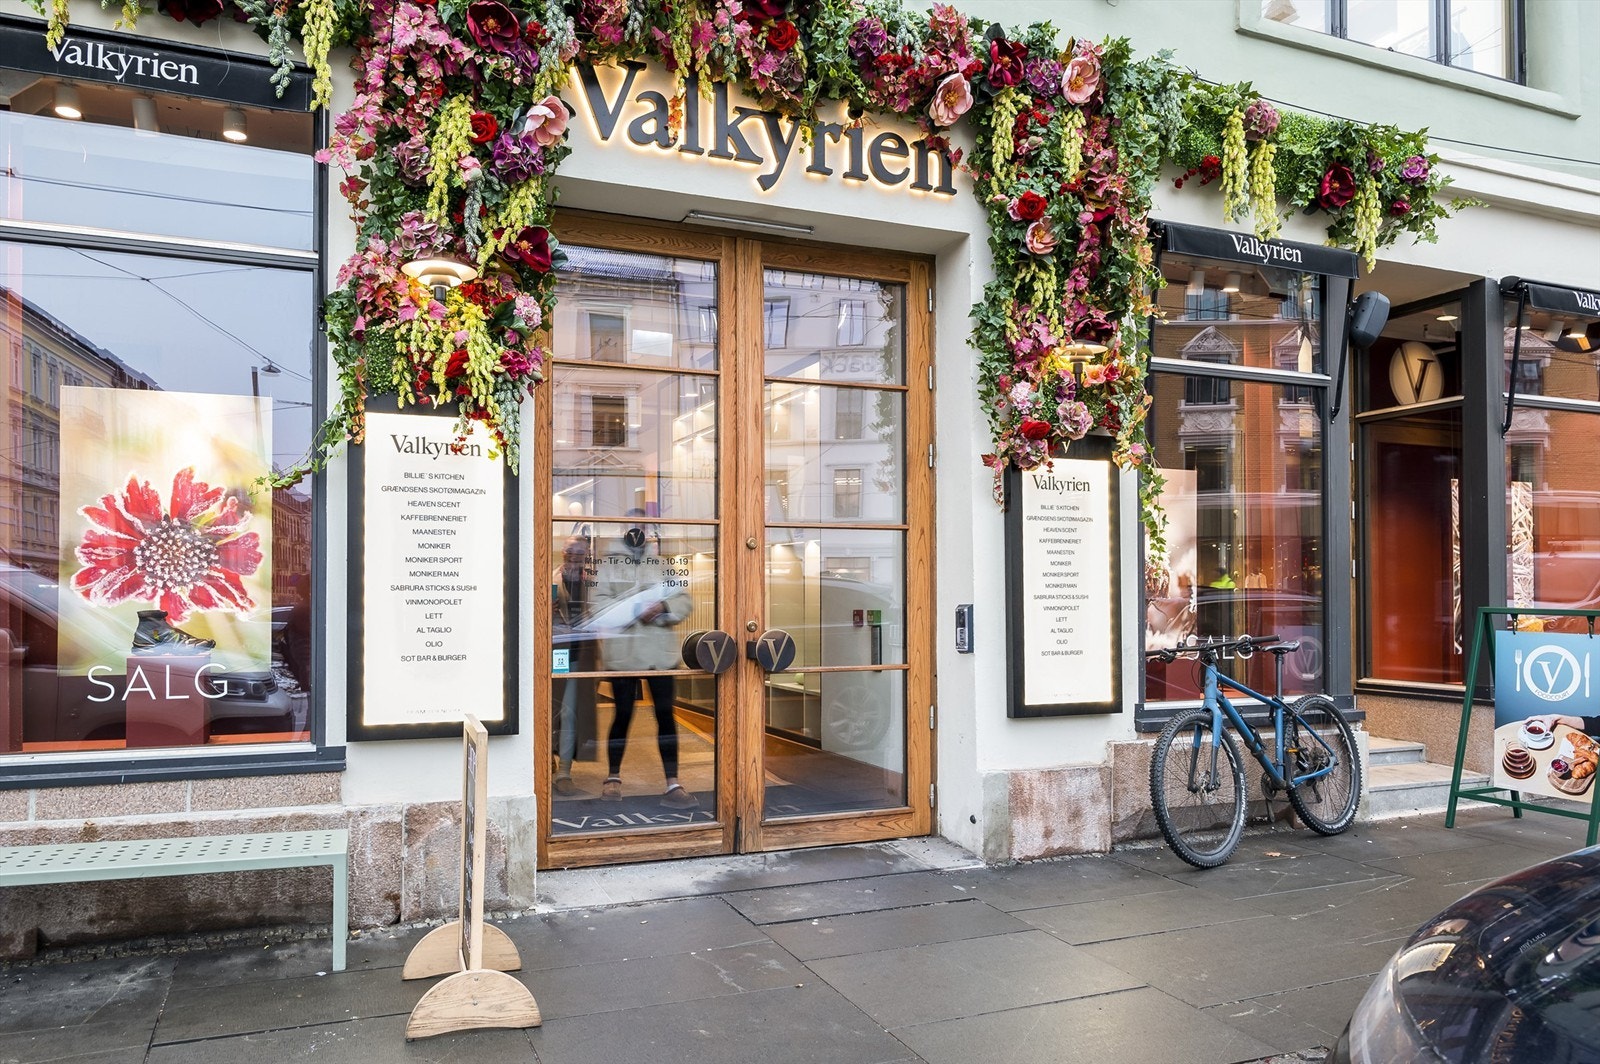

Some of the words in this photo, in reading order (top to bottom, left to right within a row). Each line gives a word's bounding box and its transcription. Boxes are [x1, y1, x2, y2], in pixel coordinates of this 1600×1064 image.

[50, 38, 199, 85] Valkyrien
[575, 58, 957, 196] Valkyrien
[1229, 234, 1303, 264] Valkyrien
[434, 472, 465, 480] KITCHEN
[1032, 474, 1091, 495] Valkyrien
[381, 486, 428, 495] GRÆNDSENS
[428, 486, 487, 495] SKOTØIMAGAZIN
[407, 500, 436, 508] HEAVEN
[437, 500, 461, 508] SCENT
[400, 514, 467, 522] KAFFEBRENNERIET
[412, 528, 457, 536] MAANESTEN
[418, 542, 451, 550] MONIKER
[405, 556, 438, 564] MONIKER
[439, 556, 463, 564] SPORT
[608, 557, 619, 565] Tir
[646, 557, 660, 565] Fre
[409, 570, 442, 578] MONIKER
[443, 570, 460, 578] MAN
[390, 584, 424, 592] SABRURA
[425, 584, 450, 592] STICKS
[451, 584, 456, 592] &
[456, 584, 478, 592] SUSHI
[405, 598, 463, 606] VINMONOPOLET
[424, 612, 443, 620] LETT
[416, 626, 426, 634] AL
[427, 626, 452, 634] TAGLIO
[425, 640, 443, 648] OLIO
[400, 654, 416, 663] SOT
[417, 654, 431, 663] BAR
[432, 654, 437, 663] &
[438, 654, 467, 663] BURGER
[86, 662, 229, 703] SALG
